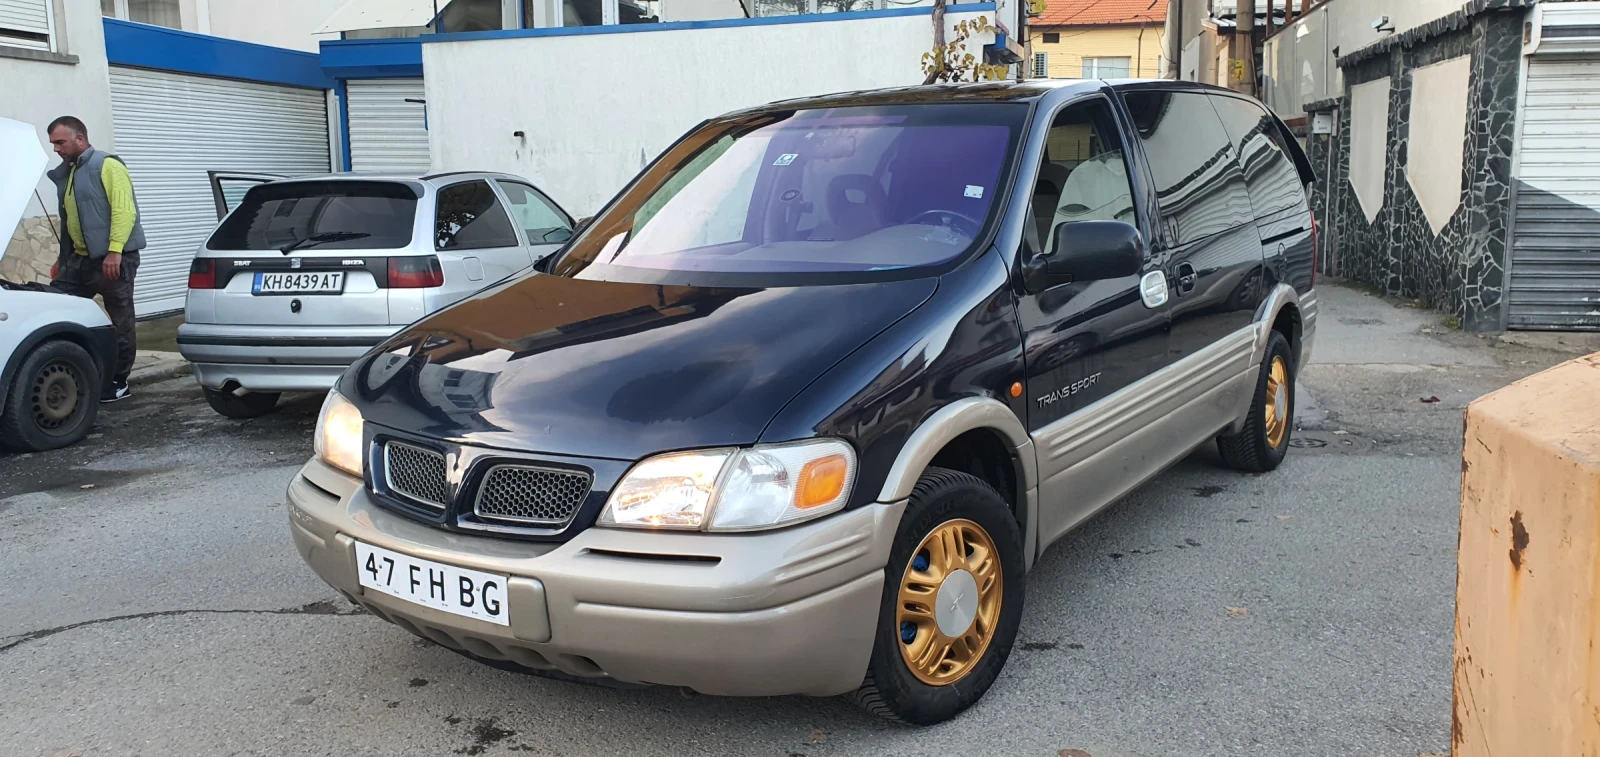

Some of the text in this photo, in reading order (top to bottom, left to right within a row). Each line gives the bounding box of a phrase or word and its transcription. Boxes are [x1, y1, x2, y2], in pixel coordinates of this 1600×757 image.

[263, 274, 340, 289] KH 8439 AT
[1037, 372, 1102, 408] TRANS SPORT
[365, 552, 500, 616] 47 FH BG
